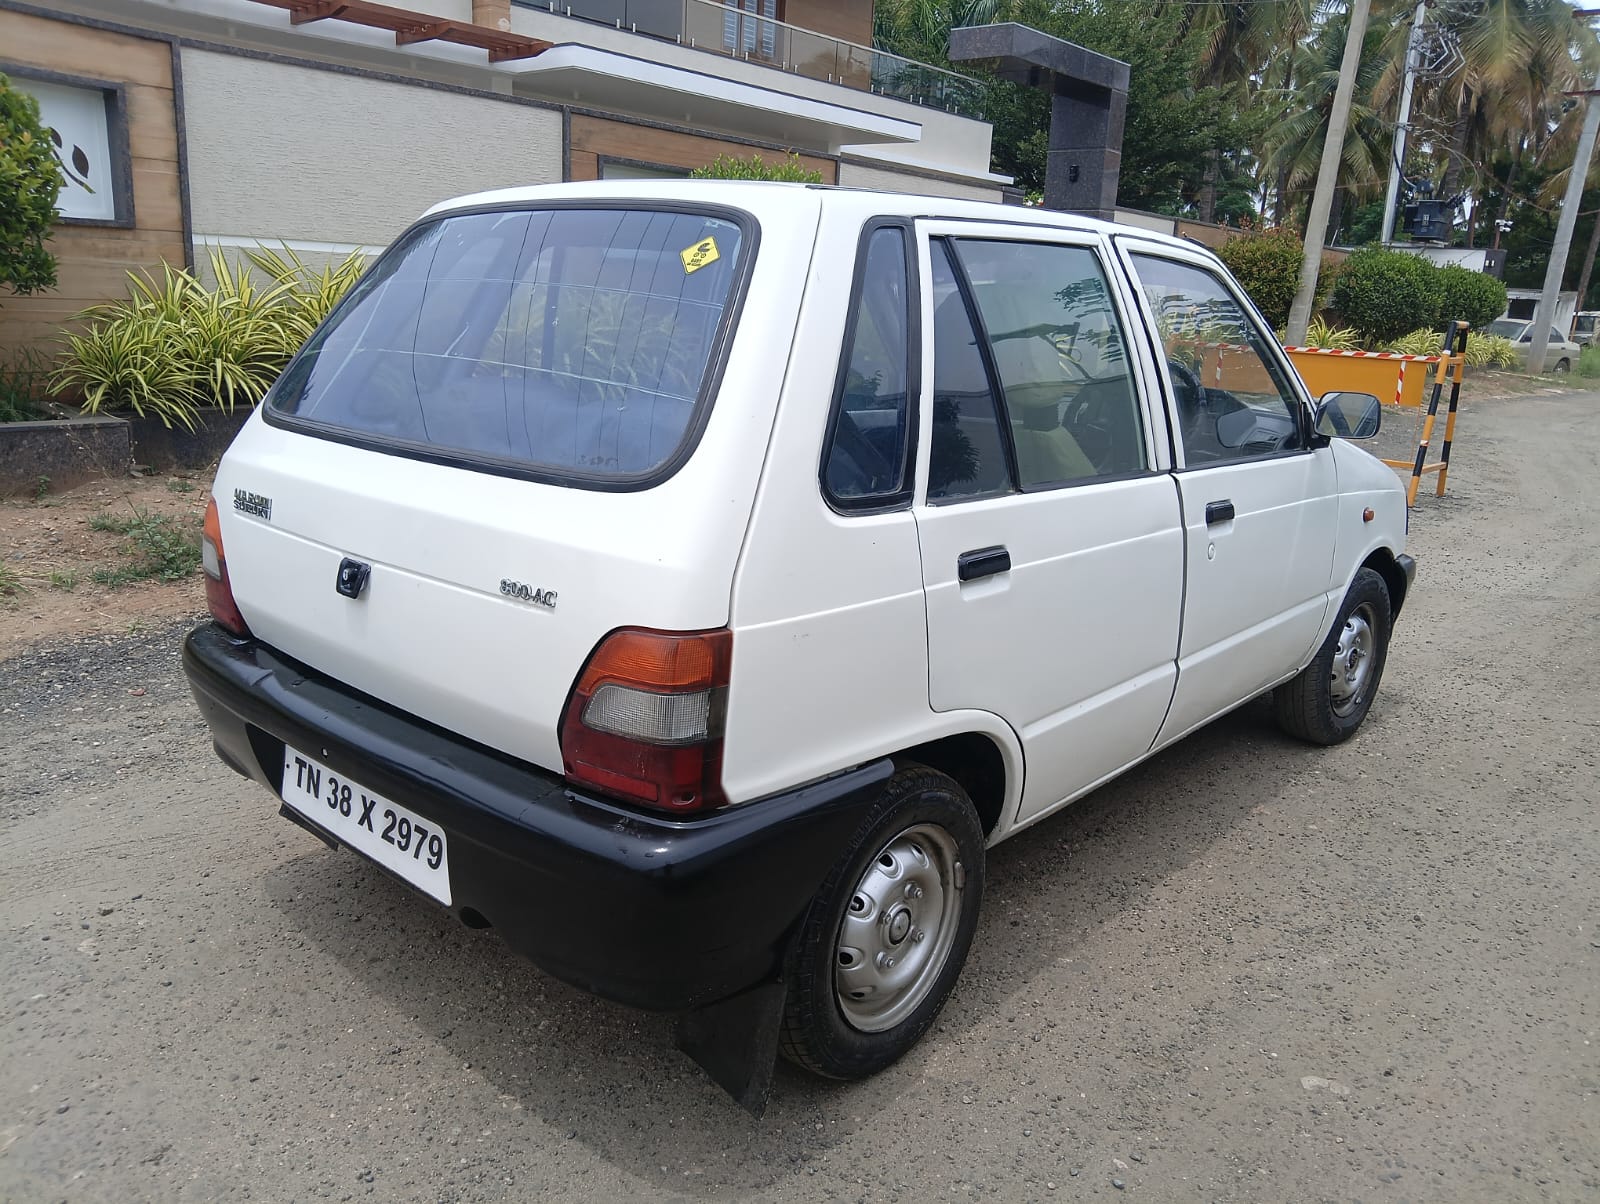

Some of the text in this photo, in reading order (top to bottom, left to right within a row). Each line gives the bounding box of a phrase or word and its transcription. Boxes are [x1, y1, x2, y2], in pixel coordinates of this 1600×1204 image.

[295, 756, 443, 870] TN 38 X 2979
